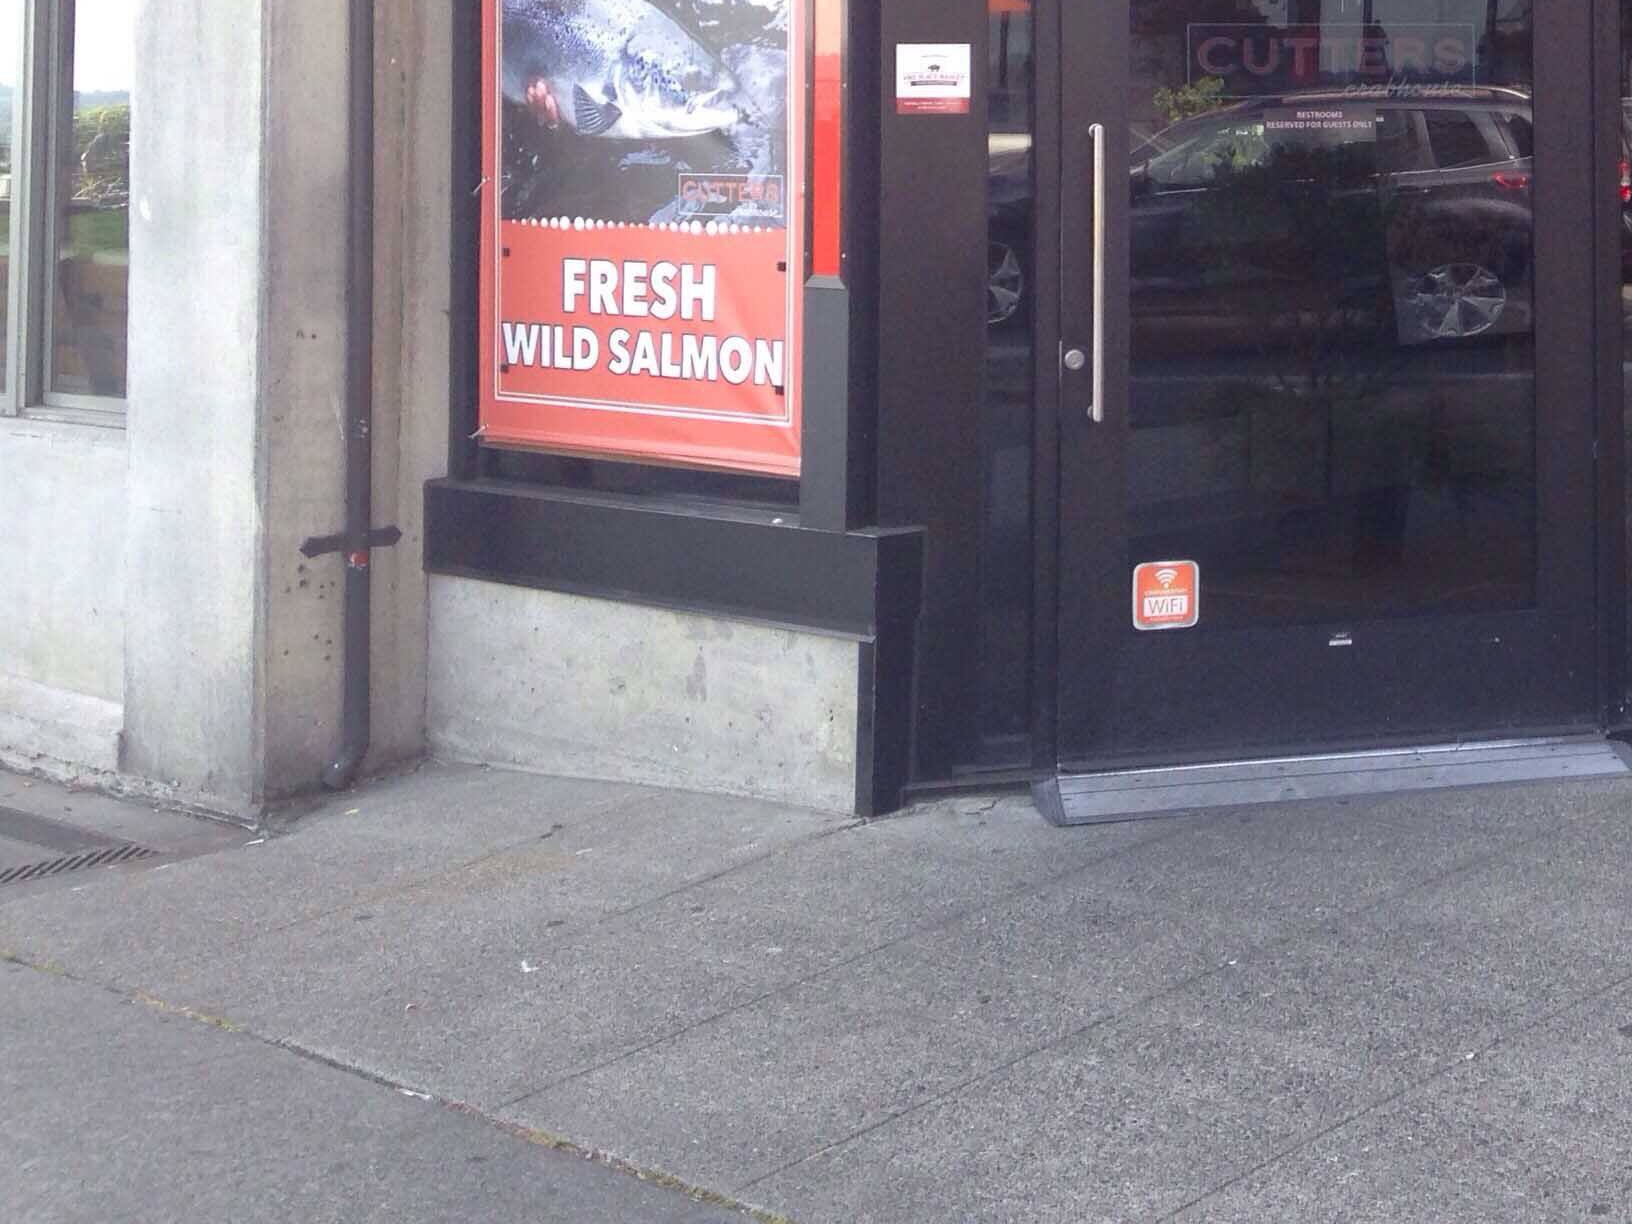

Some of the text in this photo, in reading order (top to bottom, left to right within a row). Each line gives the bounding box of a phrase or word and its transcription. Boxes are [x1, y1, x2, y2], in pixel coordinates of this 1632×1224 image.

[1196, 36, 1466, 76] CUTTERS
[1266, 120, 1373, 129] RESERVED FOR GUESTS ONLY
[1296, 110, 1344, 120] RESTROOMS
[561, 256, 718, 322] FRESH
[501, 322, 785, 389] WILD SALMON
[1148, 598, 1184, 614] WiFi
